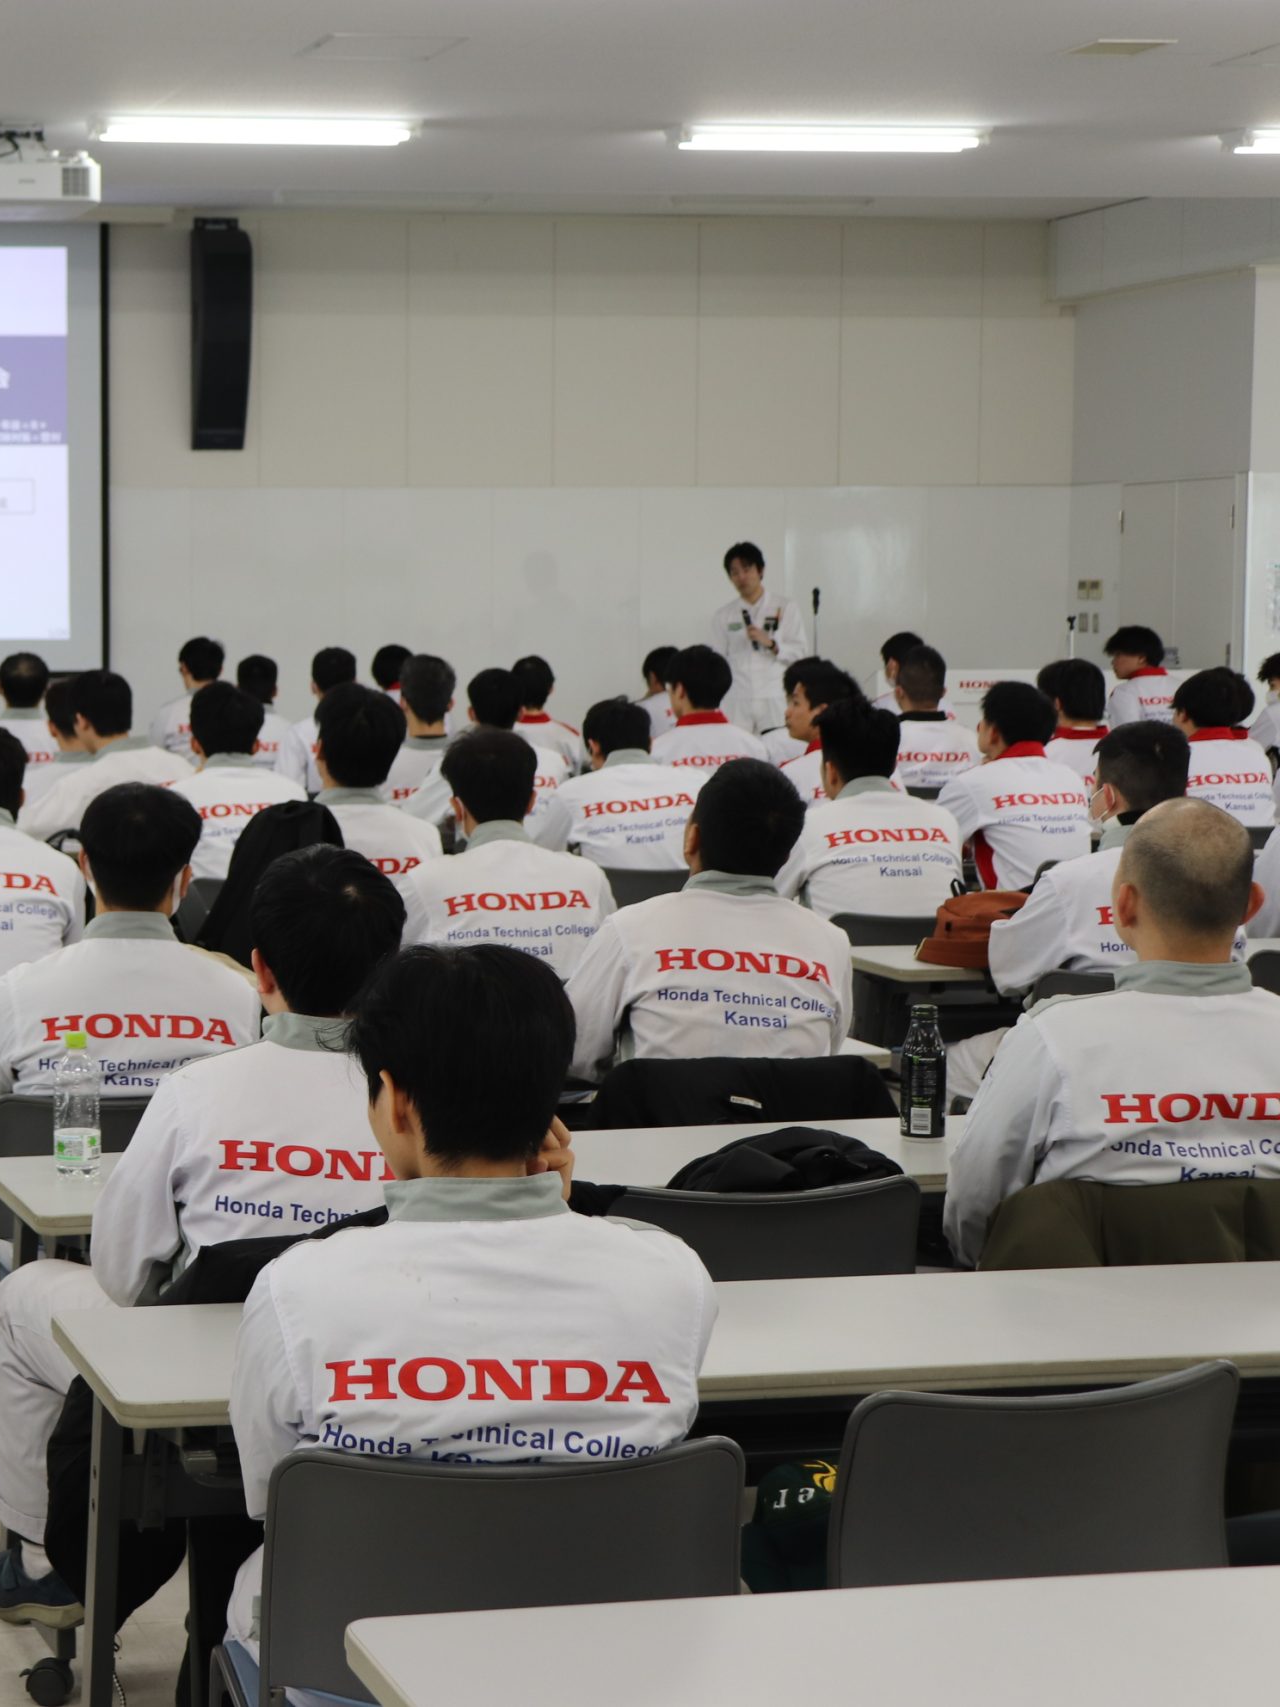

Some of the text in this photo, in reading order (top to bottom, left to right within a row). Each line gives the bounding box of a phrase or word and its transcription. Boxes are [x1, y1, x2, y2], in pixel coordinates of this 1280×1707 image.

[582, 793, 695, 818] HONDA
[991, 792, 1087, 810] HONDA
[824, 827, 951, 849] HONDA
[879, 866, 922, 878] Kansai
[443, 889, 592, 917] HONDA
[447, 927, 490, 942] Honda
[492, 925, 553, 939] Technical
[655, 948, 832, 986] HONDA
[657, 988, 709, 1002] Honda
[713, 989, 787, 1008] Technical
[41, 1013, 236, 1046] HONDA
[724, 1010, 787, 1029] Kansai
[98, 1058, 176, 1073] Technical
[104, 1072, 160, 1088] Kans
[1100, 1093, 1280, 1123] HOND
[1165, 1139, 1256, 1159] Technical
[219, 1140, 398, 1182] HON
[215, 1195, 283, 1220] Honda
[325, 1357, 671, 1404] HONDA
[321, 1423, 412, 1456] Honda
